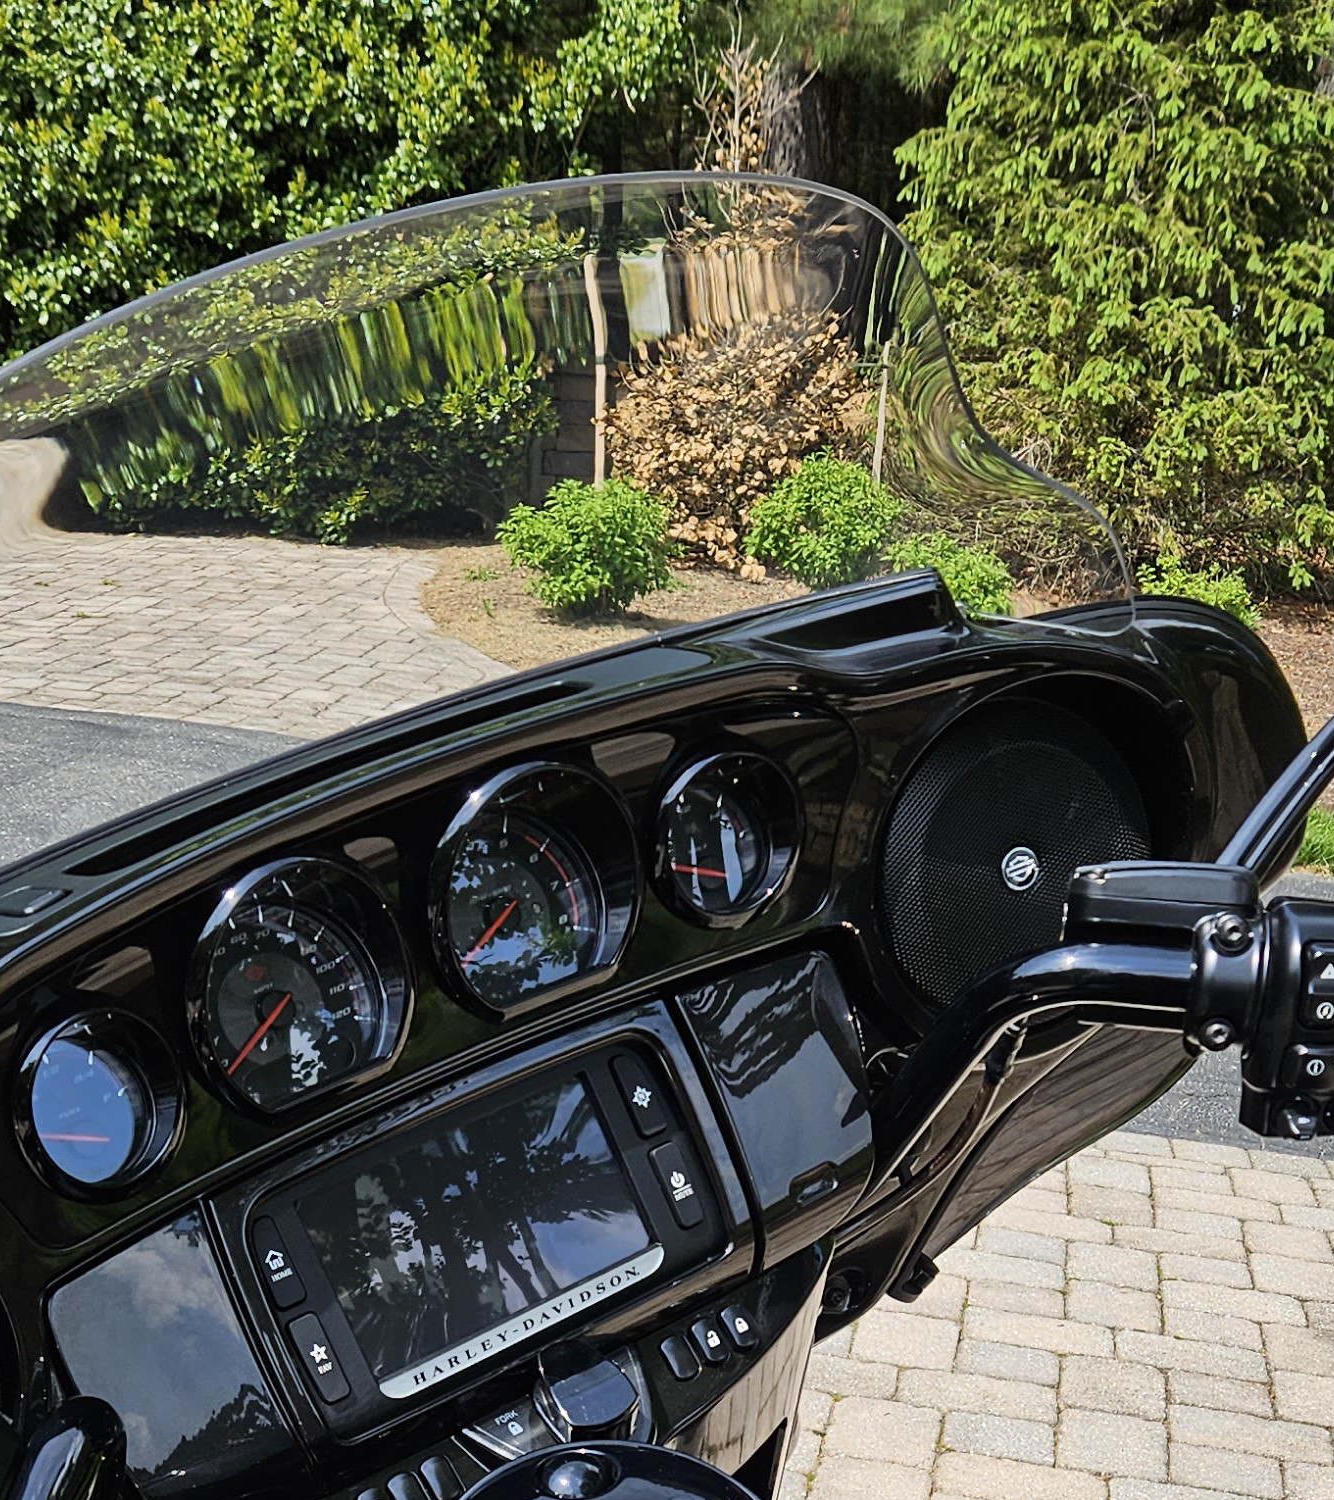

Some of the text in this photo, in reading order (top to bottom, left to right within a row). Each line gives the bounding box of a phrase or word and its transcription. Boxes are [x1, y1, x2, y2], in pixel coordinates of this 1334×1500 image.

[316, 960, 337, 975] 100
[329, 983, 346, 995] 110
[270, 1267, 294, 1283] HOME
[413, 1265, 640, 1386] HARLEY-DAVIDSON
[317, 1361, 333, 1375] FAV
[494, 1410, 519, 1426] FORK
